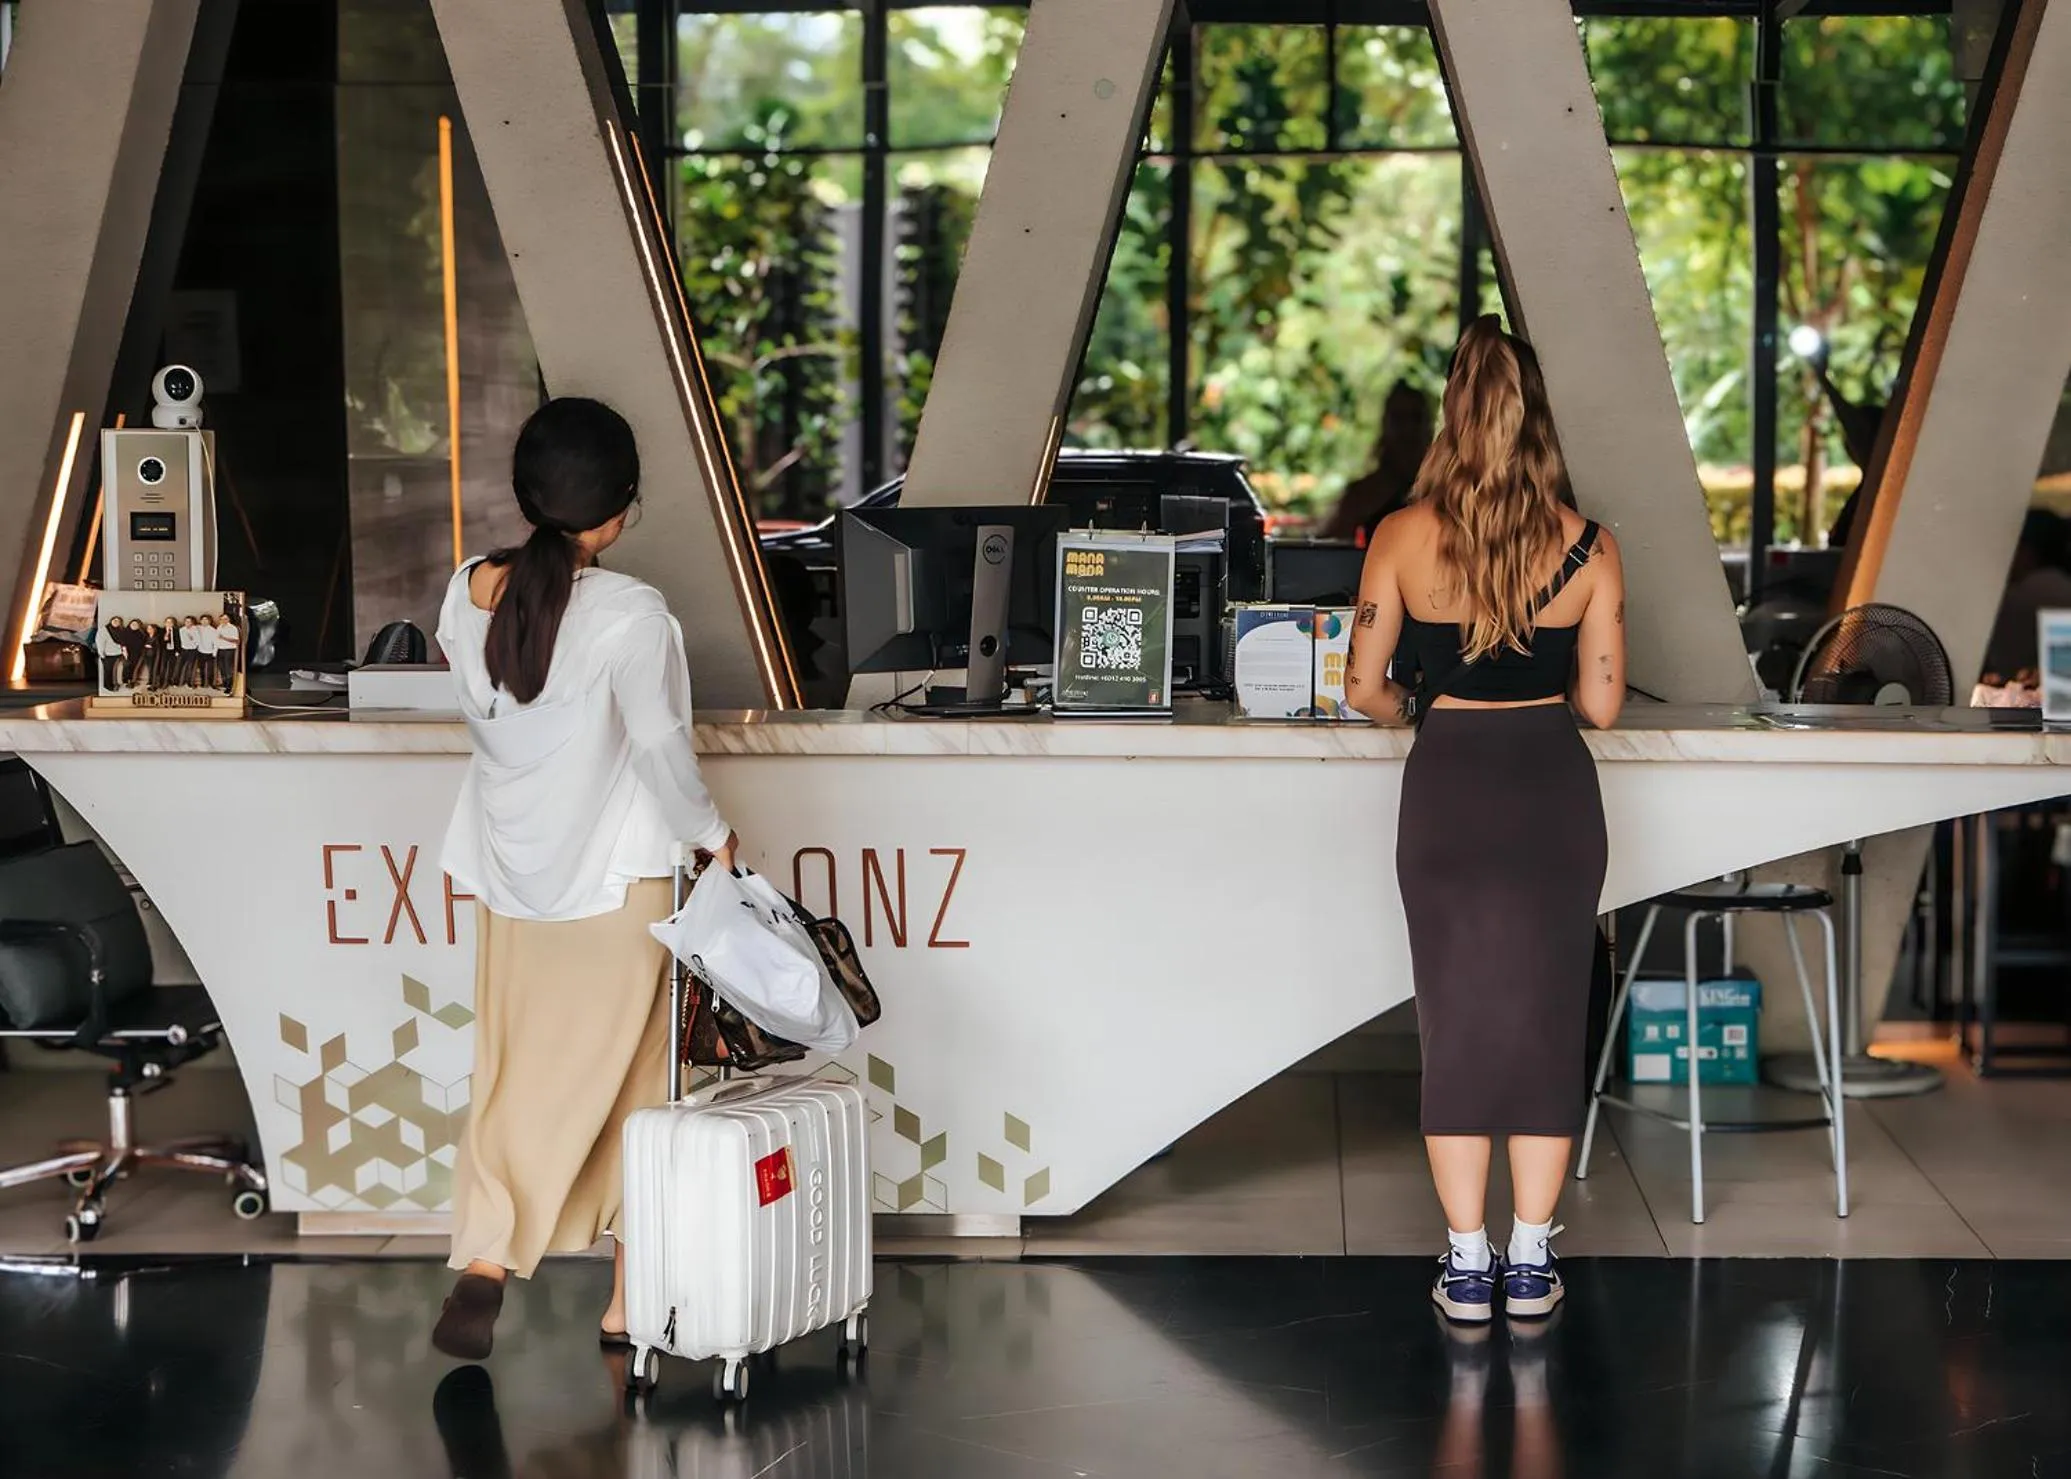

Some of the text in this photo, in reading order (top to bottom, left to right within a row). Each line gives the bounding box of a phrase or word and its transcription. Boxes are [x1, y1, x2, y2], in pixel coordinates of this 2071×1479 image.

[1066, 552, 1105, 564] MANA
[1067, 585, 1098, 593] COUNTER
[1099, 586, 1135, 595] OPERATION
[809, 1168, 824, 1246] GOOD
